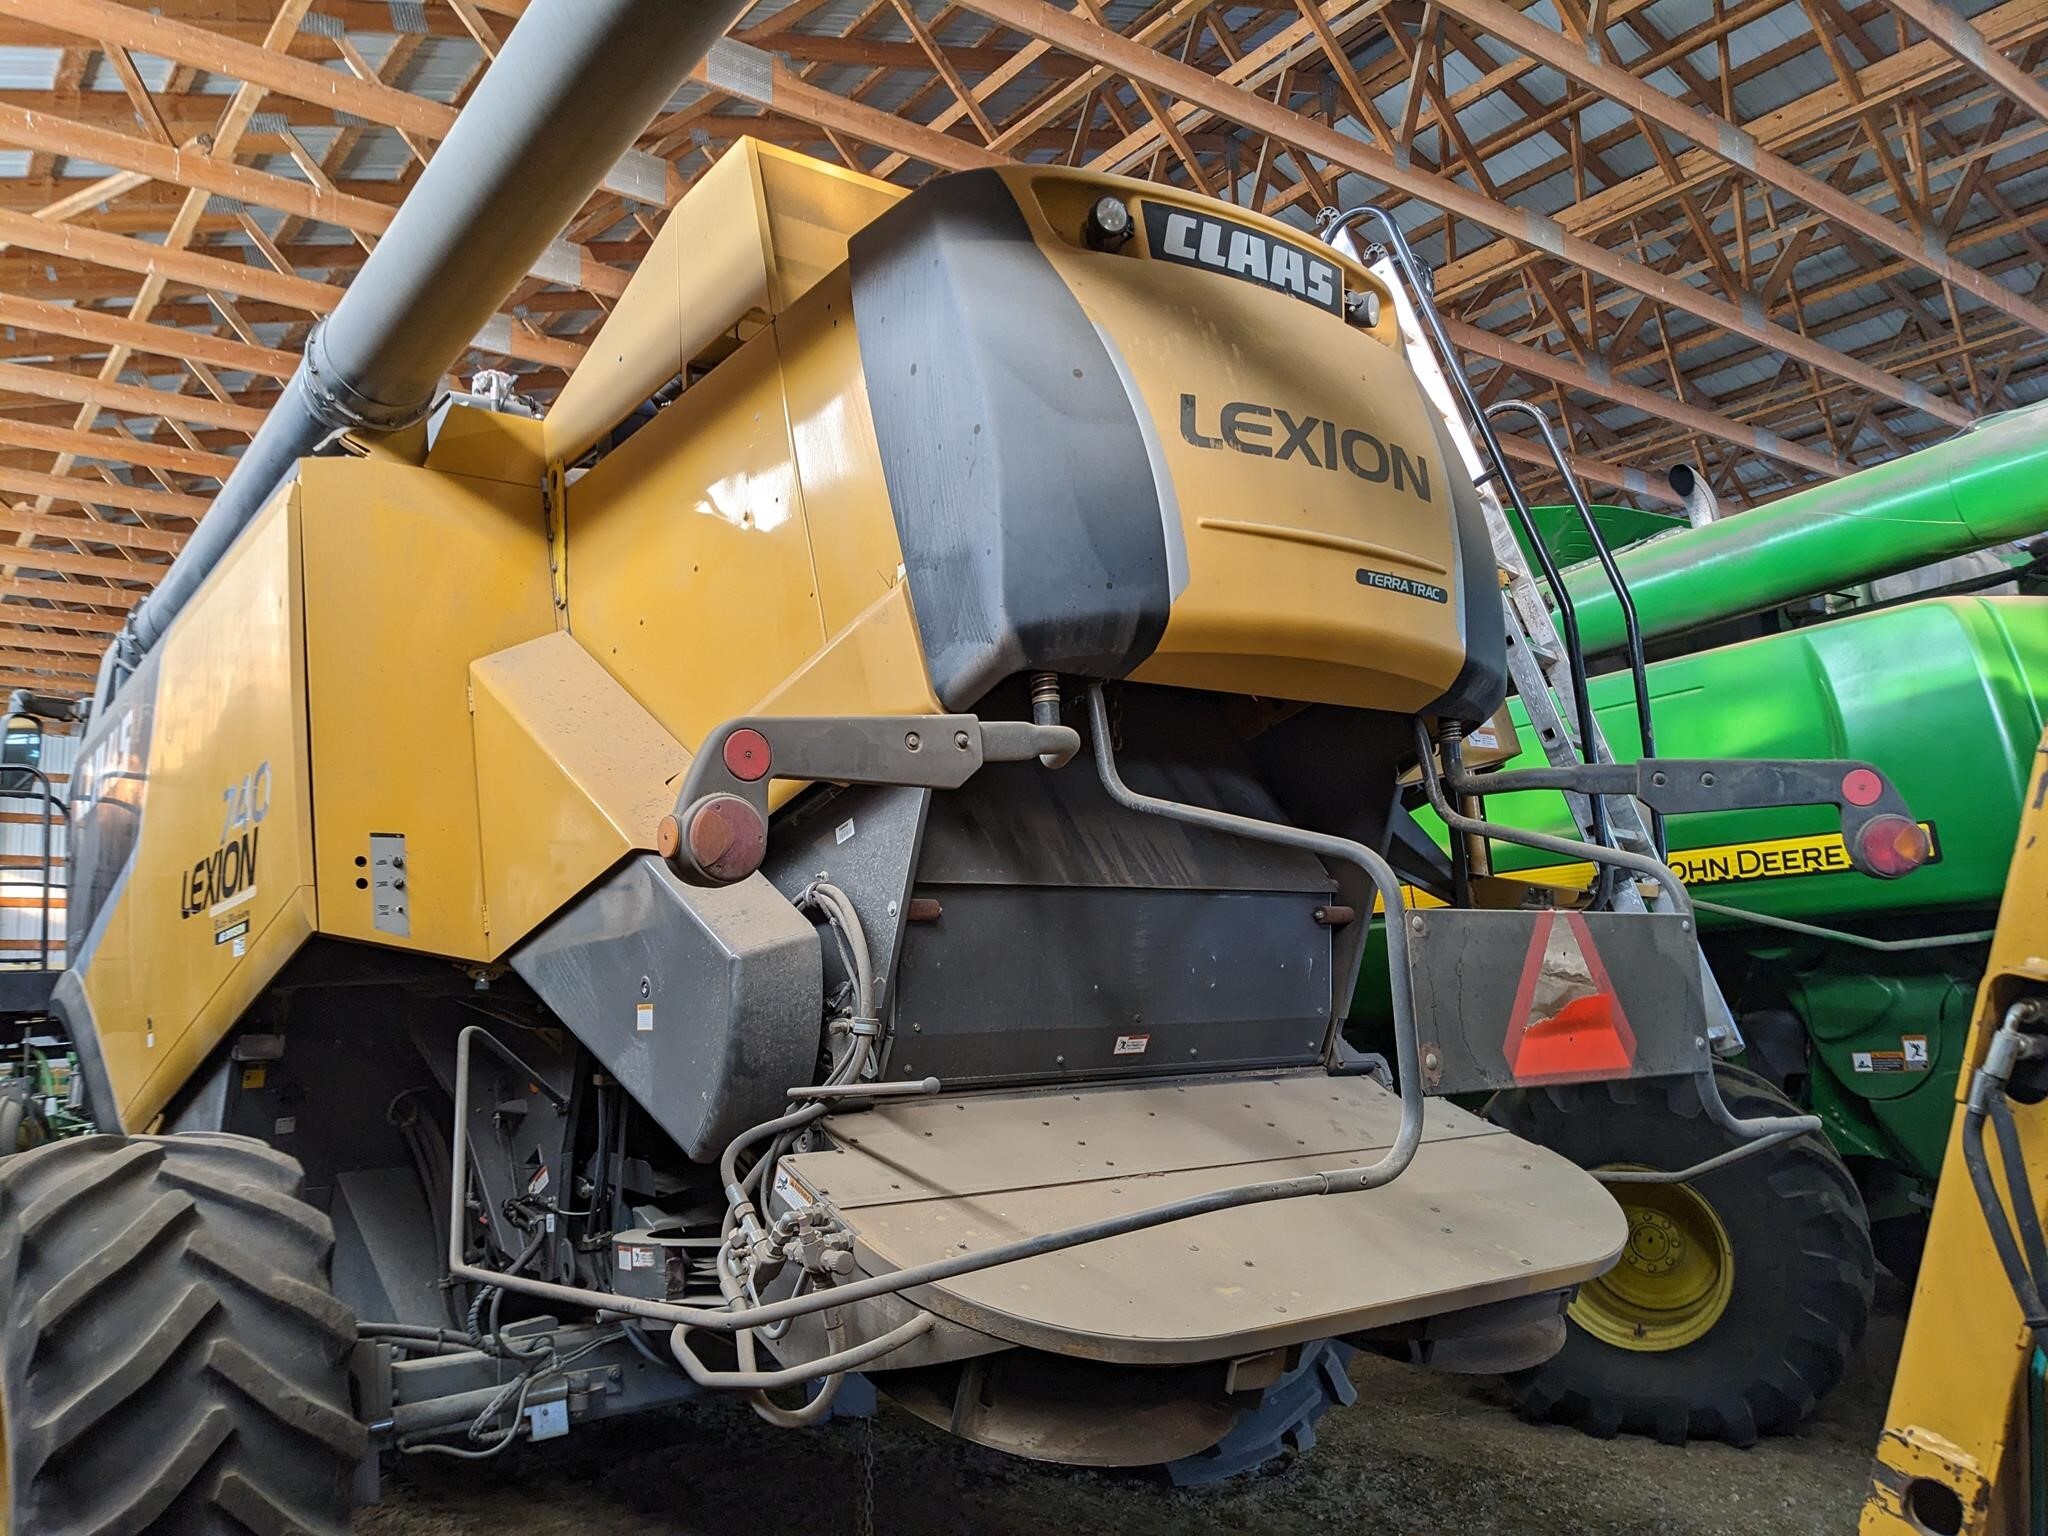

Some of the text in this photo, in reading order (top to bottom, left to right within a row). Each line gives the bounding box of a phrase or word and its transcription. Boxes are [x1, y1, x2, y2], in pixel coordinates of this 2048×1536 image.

[1164, 213, 1333, 306] CLAAS
[1179, 393, 1432, 503] LEXION
[1367, 572, 1440, 600] TERRA TRAC
[220, 760, 271, 845] 740
[181, 826, 259, 920] LEXION
[1668, 844, 1844, 881] OHN DEERE
